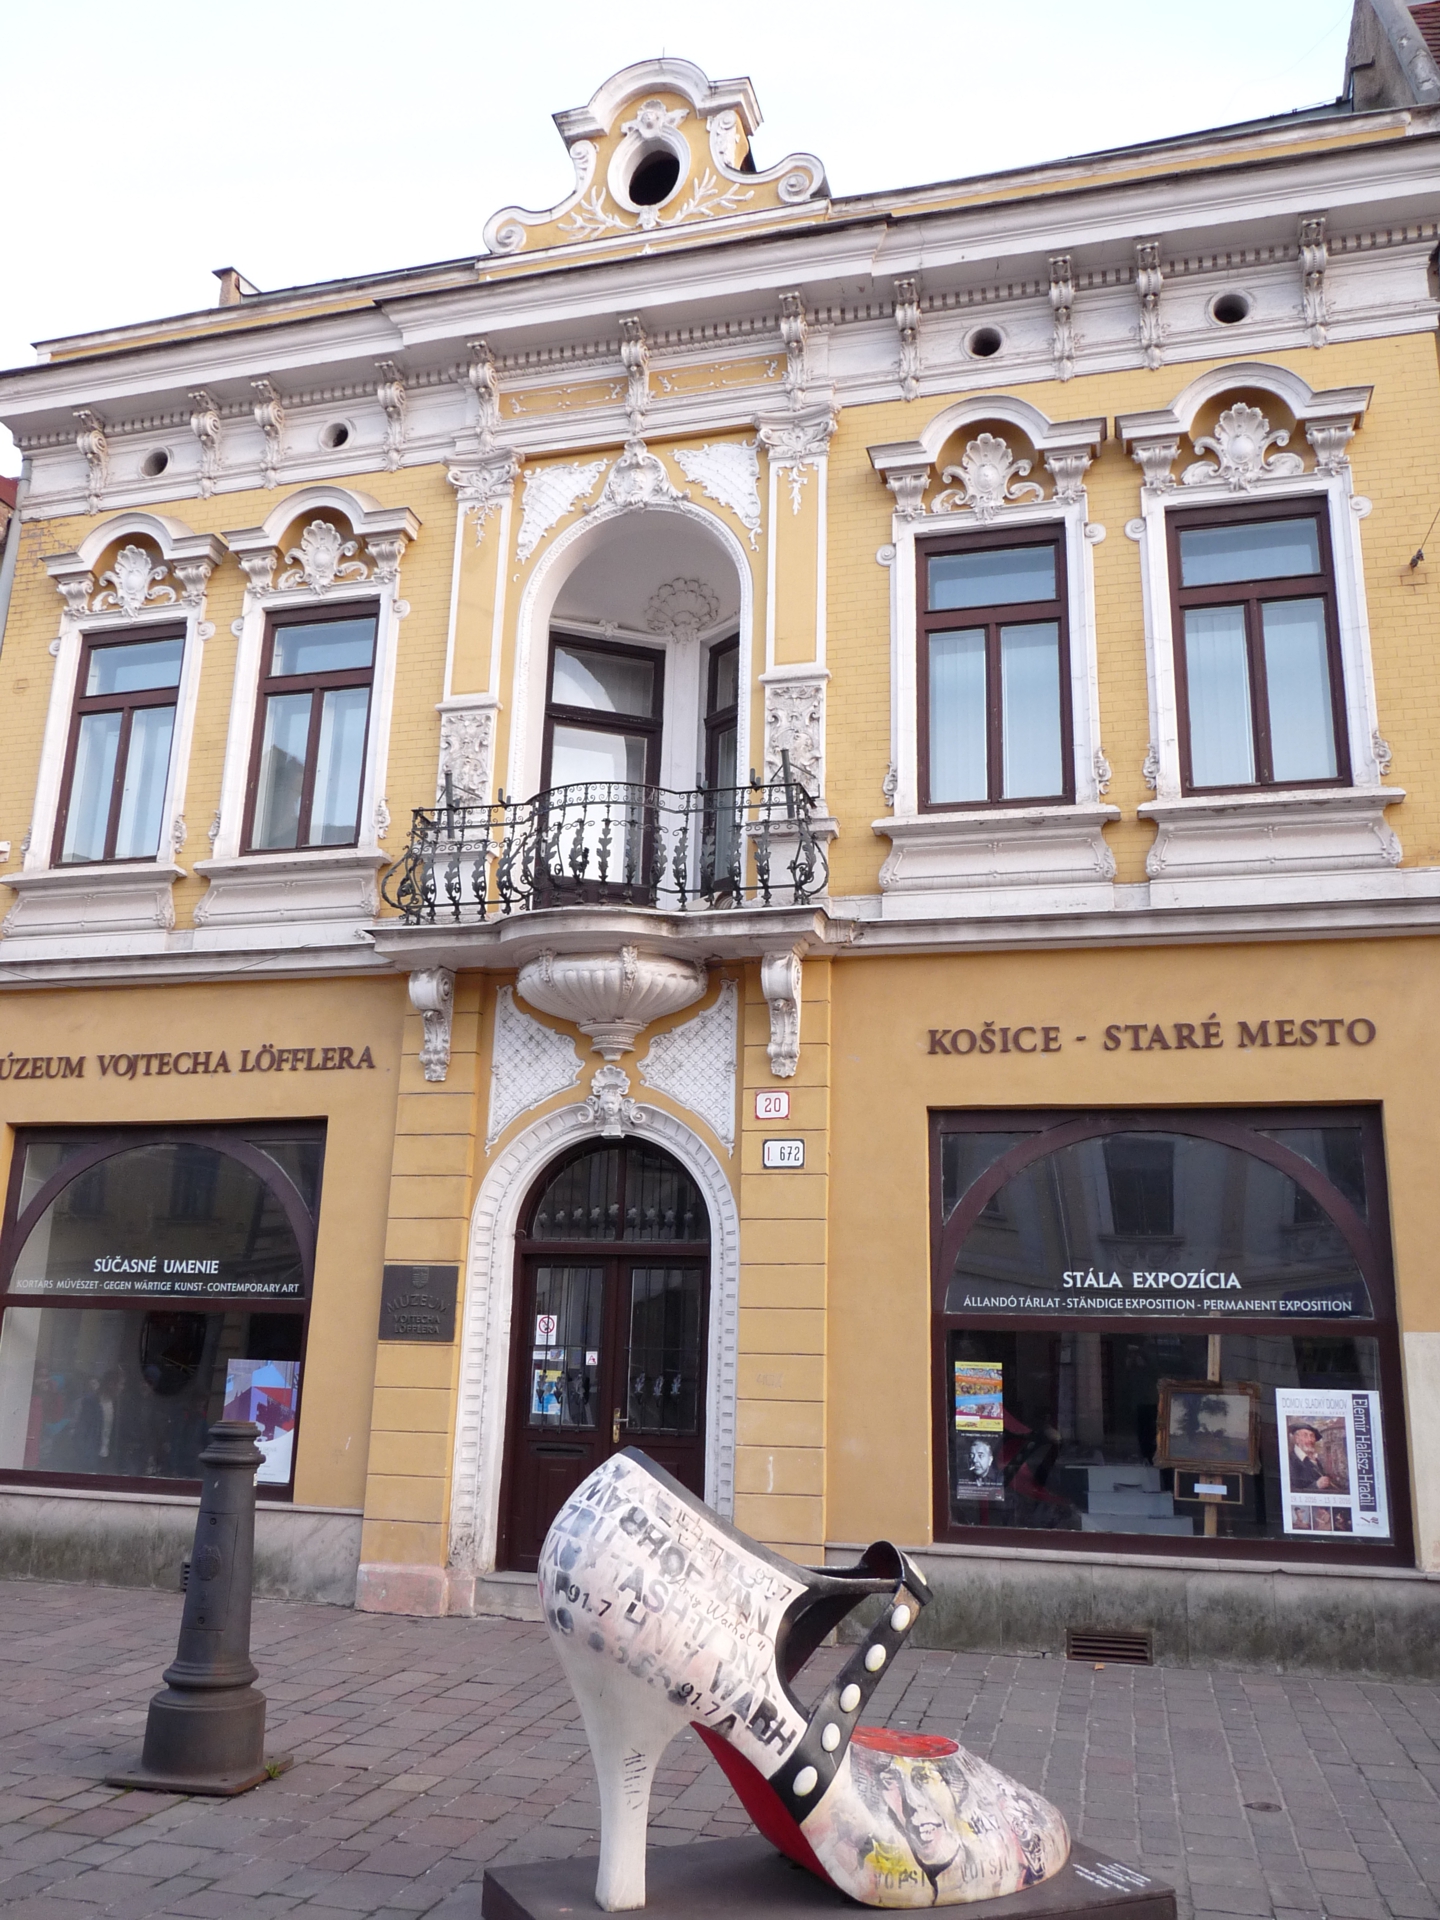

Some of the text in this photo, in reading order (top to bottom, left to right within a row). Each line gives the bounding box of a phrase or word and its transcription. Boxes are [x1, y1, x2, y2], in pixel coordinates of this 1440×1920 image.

[927, 1021, 1062, 1055] KOŠICE
[1104, 1013, 1224, 1051] STARÉ
[1238, 1018, 1377, 1048] MESTO
[0, 1043, 375, 1080] ÚZEUM VOJTECHA LÖFFLERA
[764, 1097, 781, 1113] 20
[780, 1146, 800, 1161] 672
[93, 1255, 220, 1274] SÚČASNÉ UMENIE
[1062, 1267, 1242, 1289] STÁLA EXPOZÍCIA
[963, 1295, 1017, 1308] ÁLLANDÓ
[1018, 1295, 1060, 1309] TÁRLAT
[1125, 1298, 1195, 1310] EXPOSITION
[1203, 1299, 1277, 1311] PERMANENT
[1279, 1299, 1352, 1312] EXPOSITION
[1352, 1398, 1369, 1433] Elemír
[1355, 1435, 1375, 1506] Halász-Hradil
[568, 1584, 612, 1617] 91.7
[679, 1682, 721, 1717] 91.7
